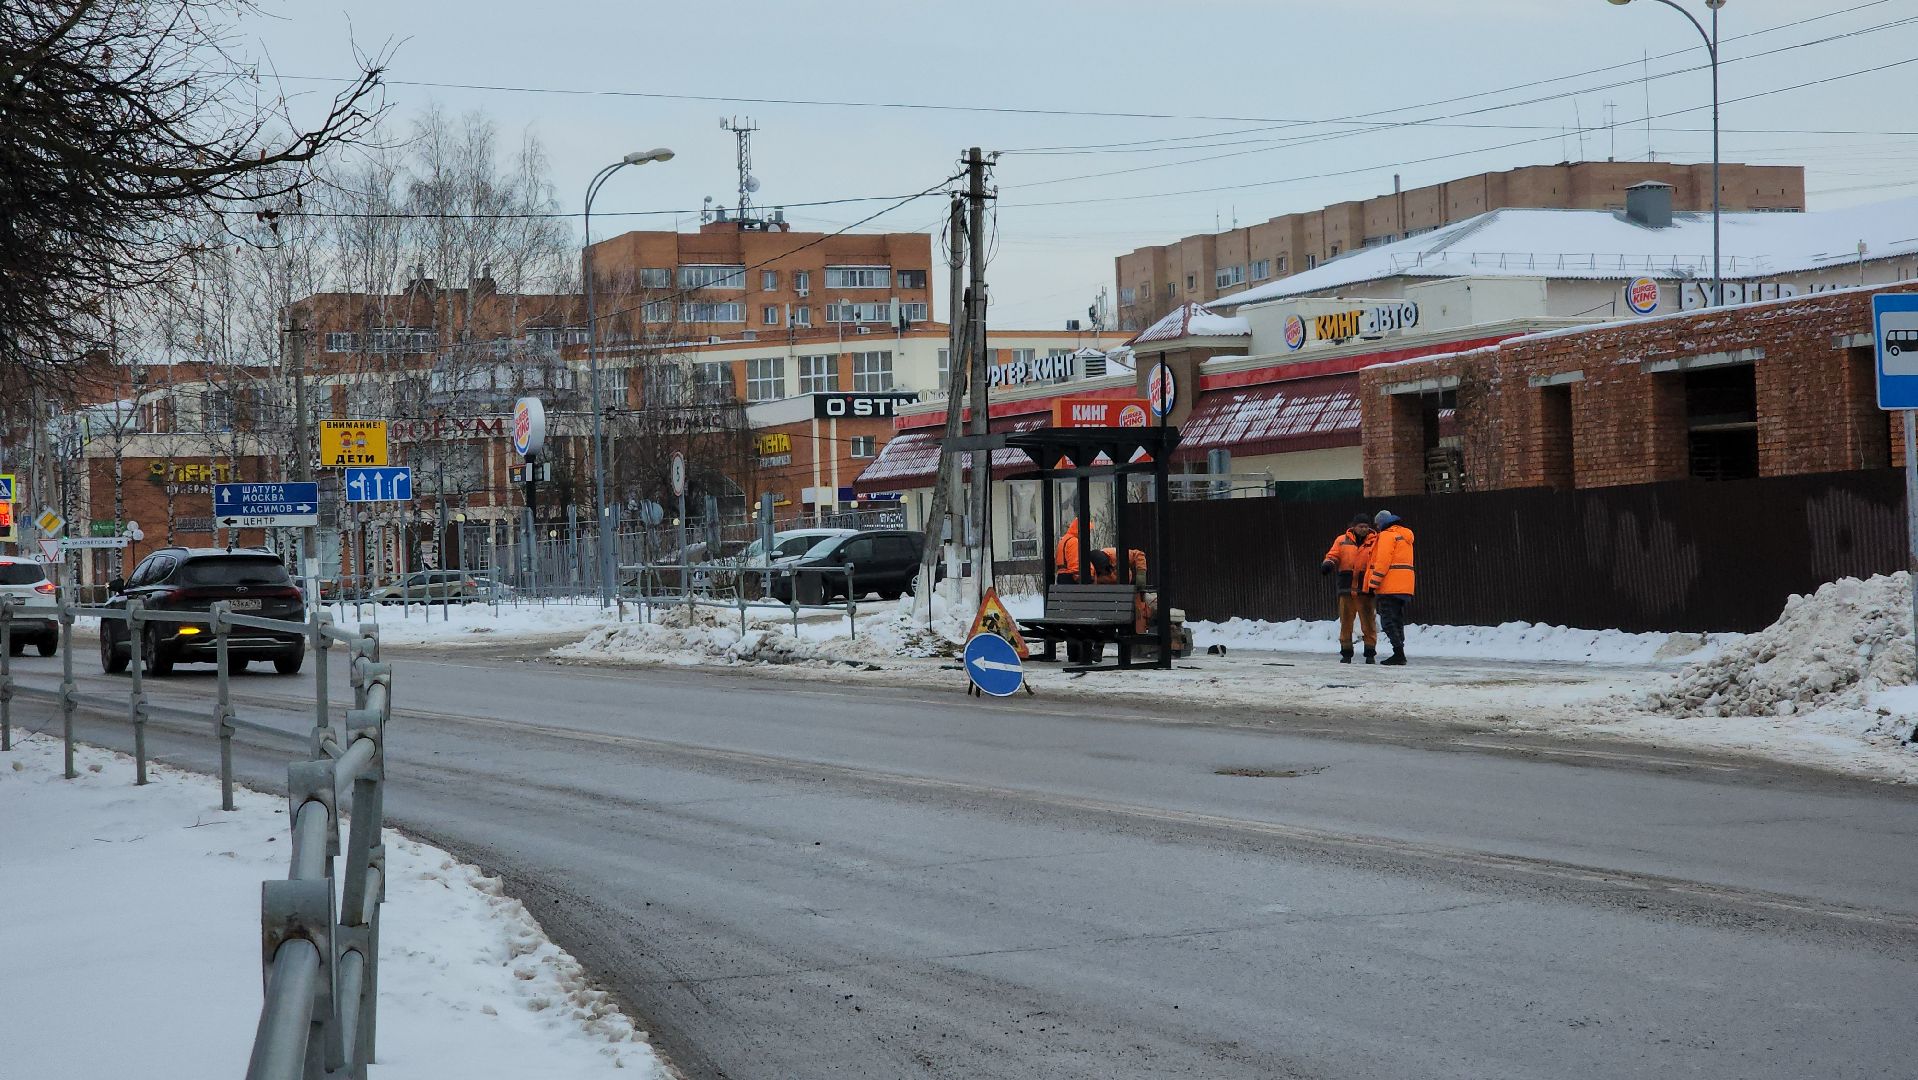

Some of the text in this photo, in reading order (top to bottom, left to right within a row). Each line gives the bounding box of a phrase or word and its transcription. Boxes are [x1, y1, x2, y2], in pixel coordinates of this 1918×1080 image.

[1633, 283, 1656, 294] BURGER
[1634, 291, 1656, 304] KING
[1315, 310, 1362, 340] КИНГ
[1032, 354, 1076, 381] КИНГ
[1072, 404, 1108, 421] КИНГ
[1122, 411, 1142, 422] BURGER
[326, 421, 381, 429] ВНИМАНИЕ!
[1123, 416, 1143, 428] KING
[335, 454, 375, 465] ДЕТИ
[676, 466, 681, 482] 5
[242, 485, 284, 494] ШАТУРА
[242, 493, 285, 502] МОСКВА
[242, 504, 293, 514] КАСИМОВ
[243, 517, 276, 526] ЦЕНТР
